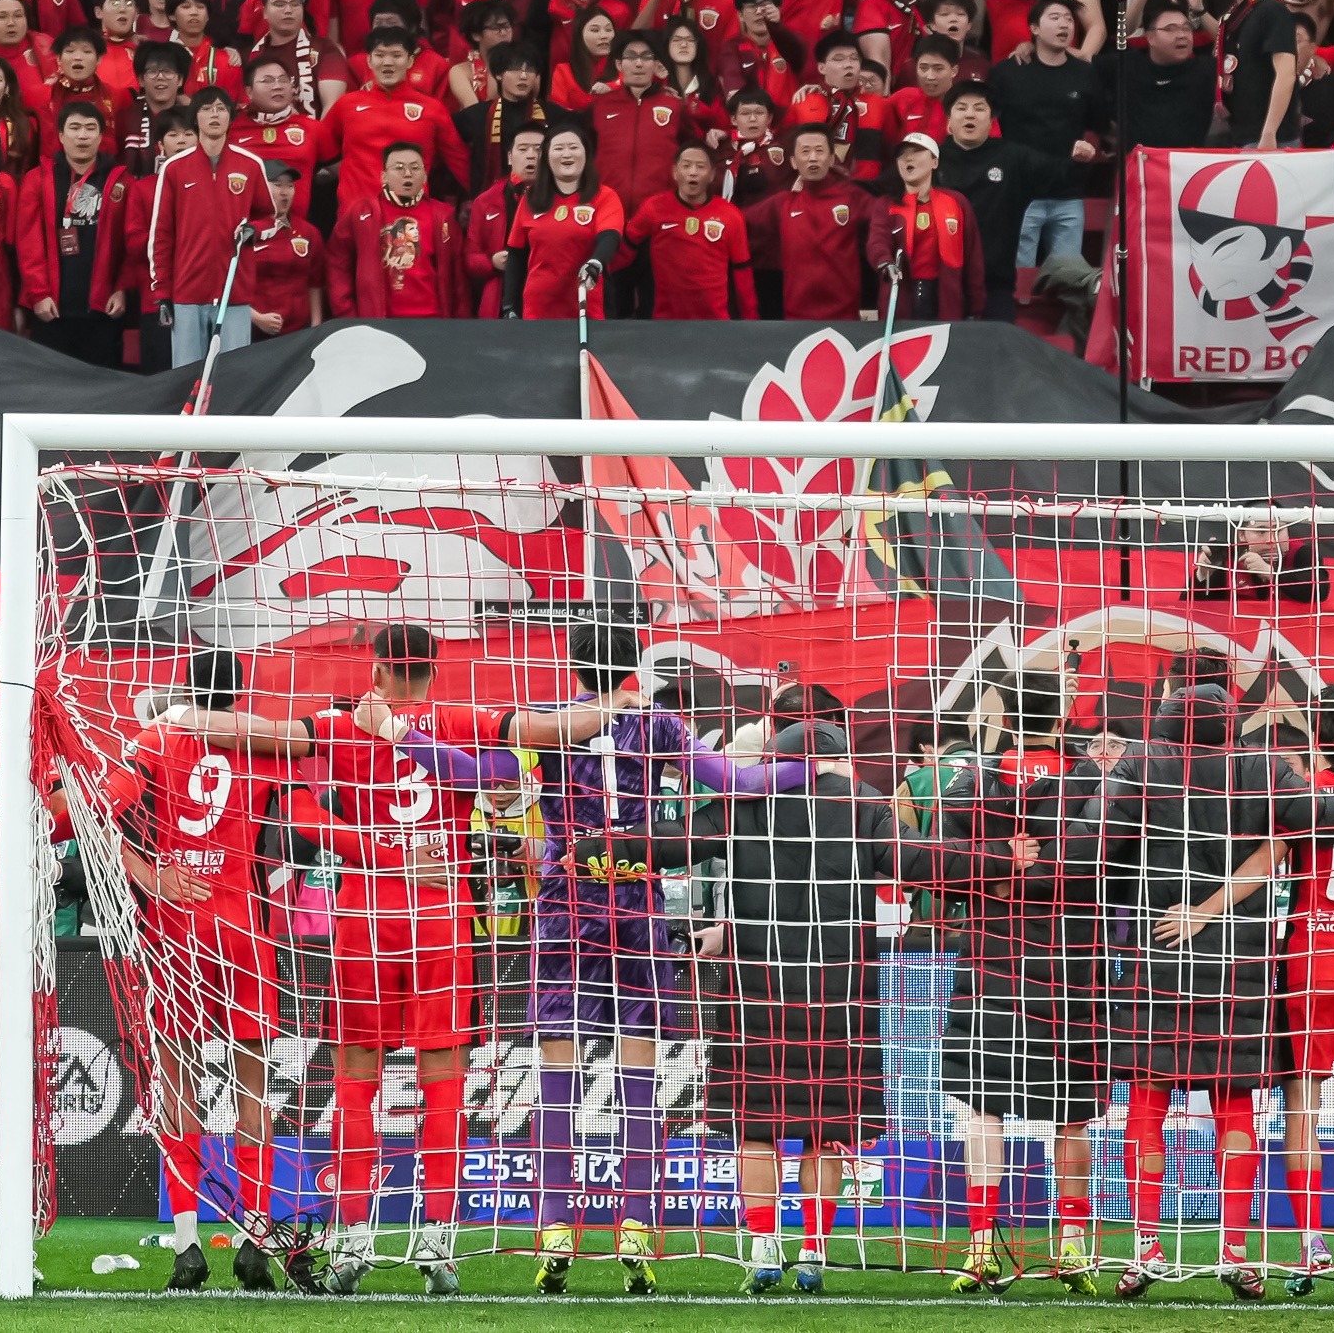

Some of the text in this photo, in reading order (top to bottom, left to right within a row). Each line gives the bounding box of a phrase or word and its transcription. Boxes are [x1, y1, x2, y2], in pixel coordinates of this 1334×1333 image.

[1179, 344, 1316, 373] RED BO
[177, 754, 232, 837] 9
[590, 735, 619, 820] 1
[468, 1194, 532, 1209] CHINA
